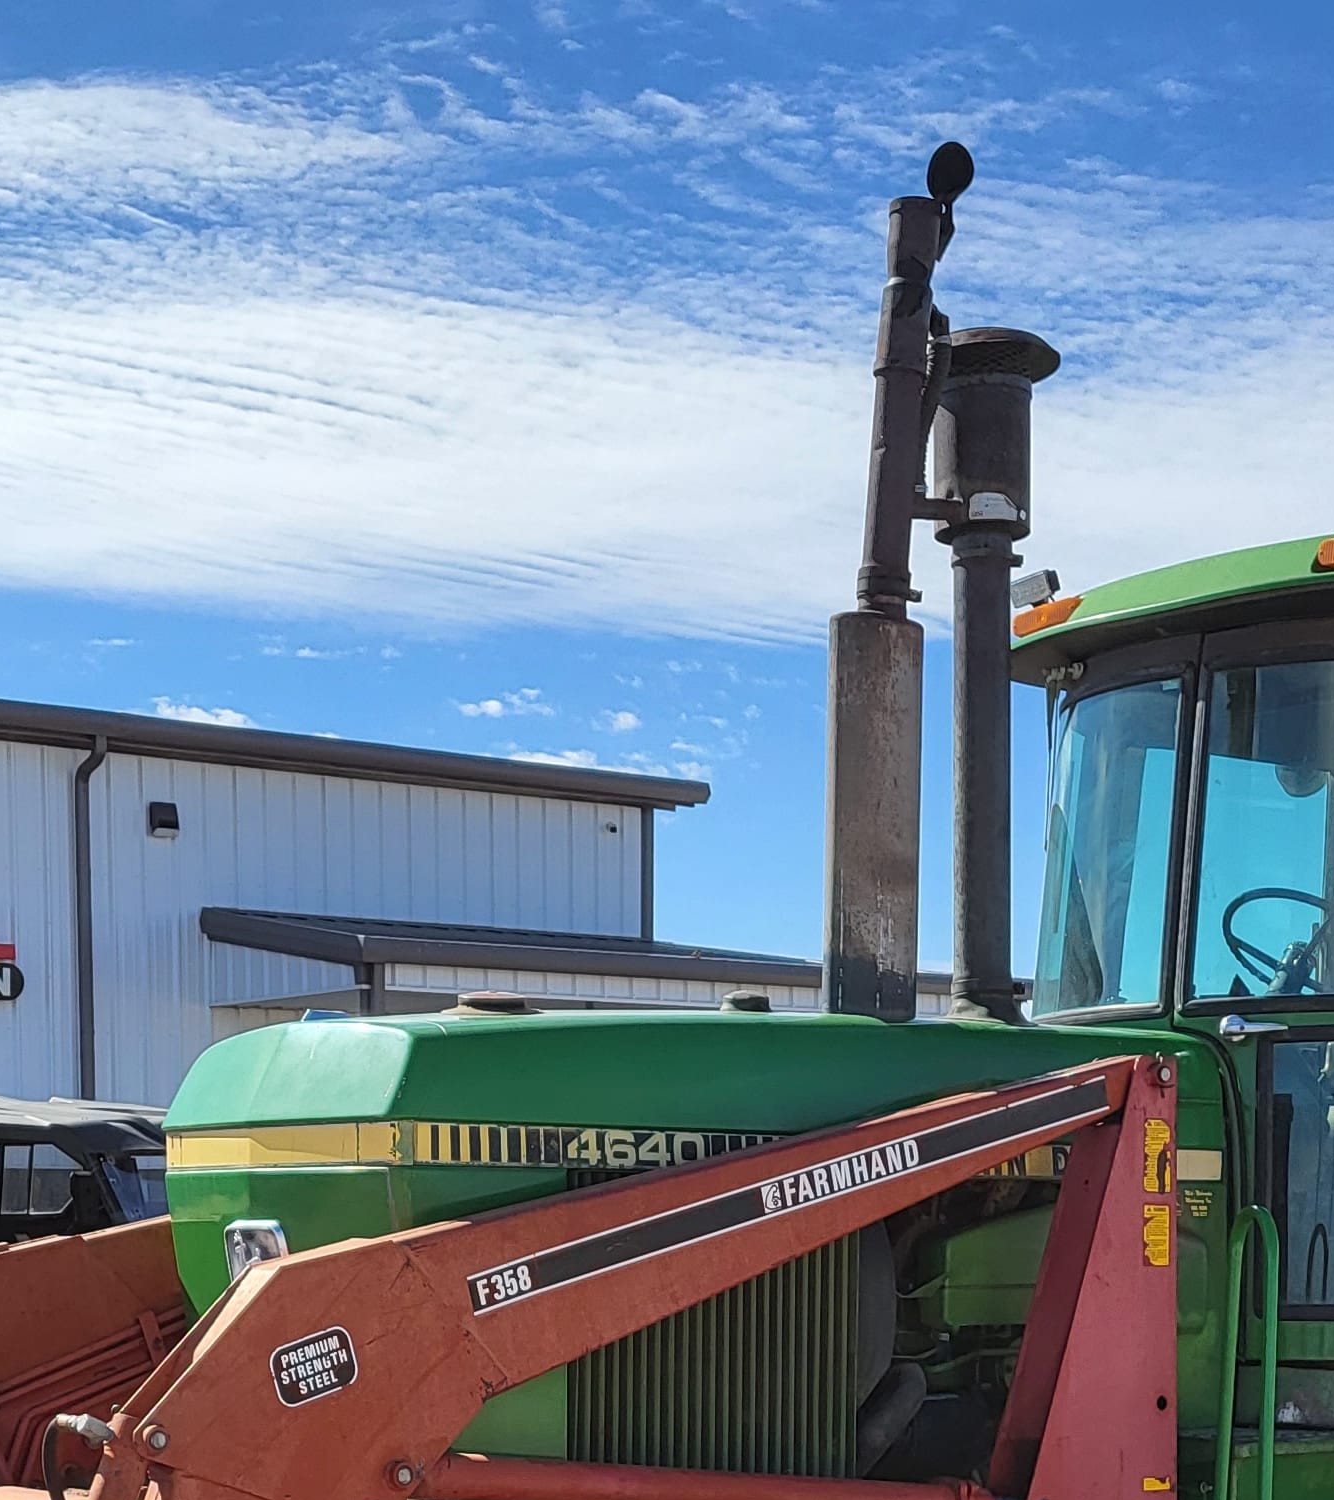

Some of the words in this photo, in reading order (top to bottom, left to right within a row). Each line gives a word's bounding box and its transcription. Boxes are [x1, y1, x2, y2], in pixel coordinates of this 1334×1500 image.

[567, 1130, 705, 1168] 4640
[783, 1139, 919, 1206] FARMHAND
[476, 1265, 532, 1305] F358
[280, 1336, 340, 1368] PREMIUM
[280, 1349, 348, 1384] STRENGTH
[299, 1370, 338, 1394] STEEL
